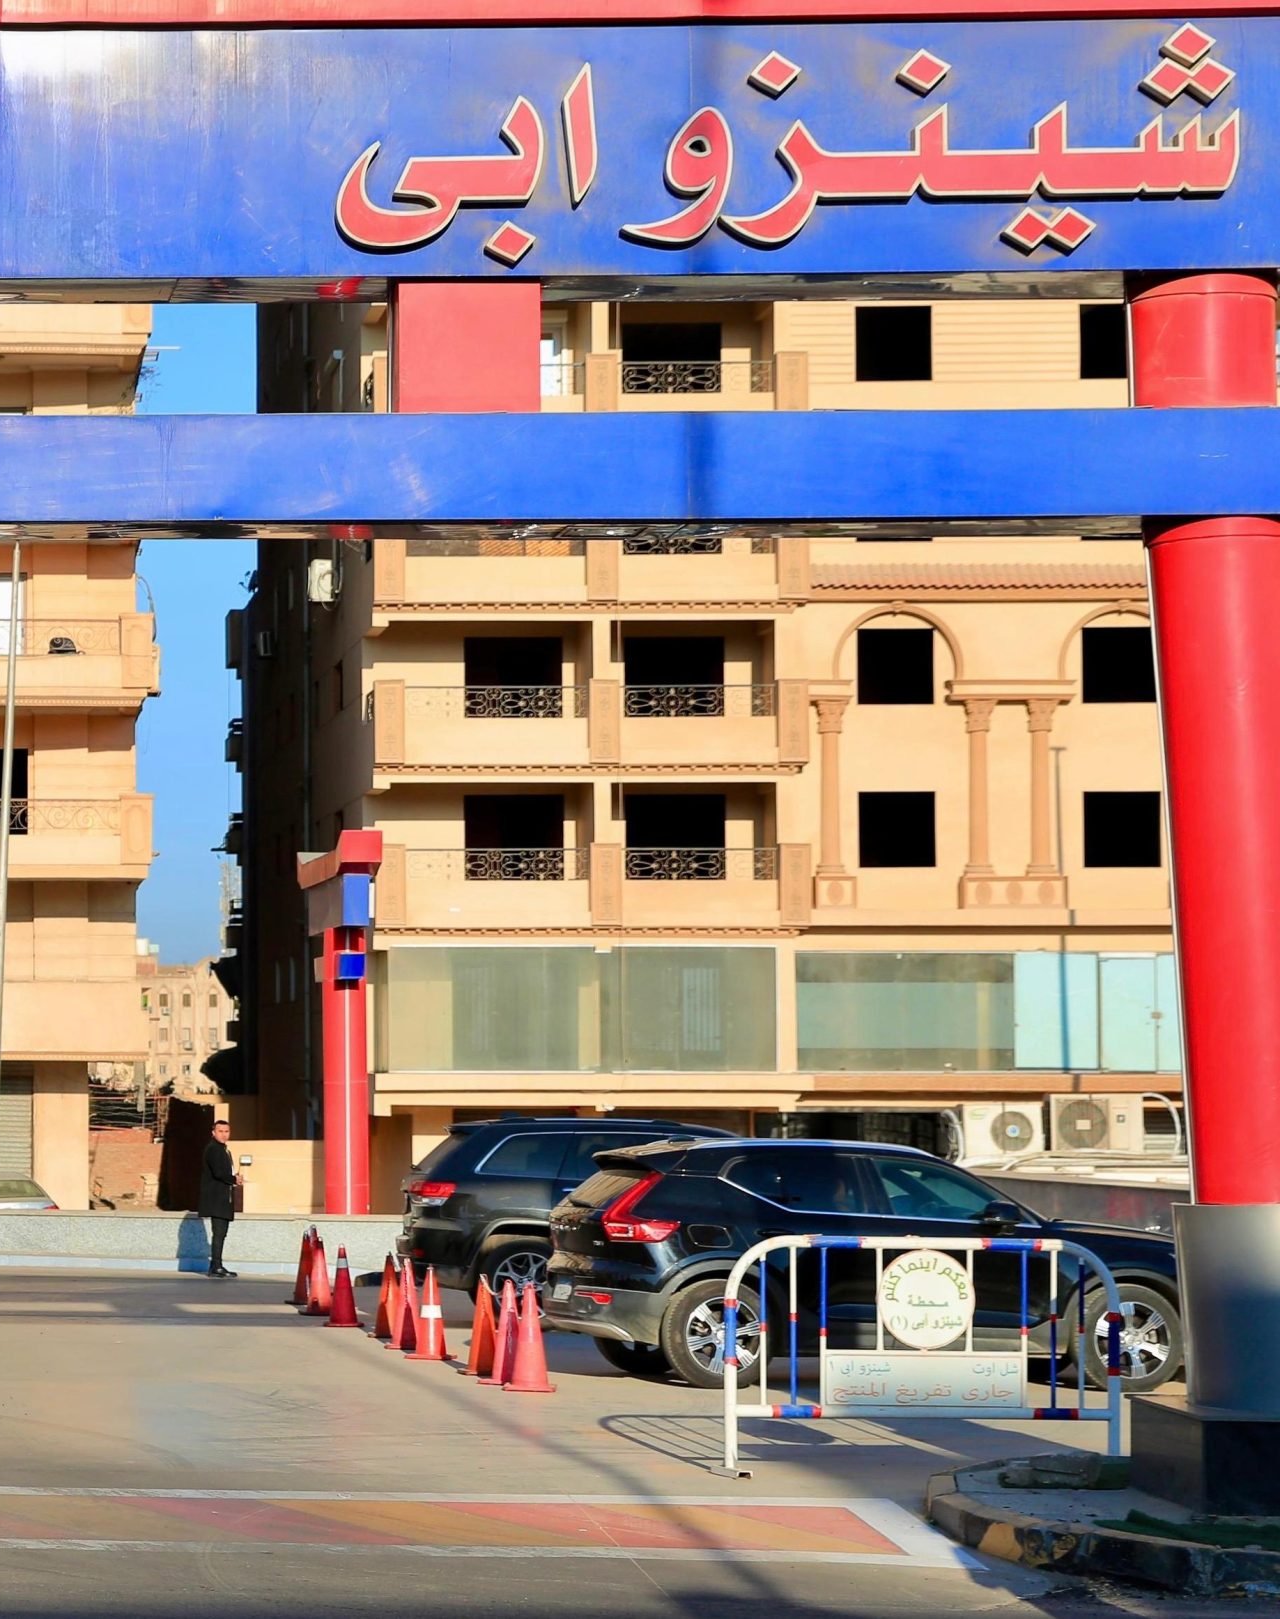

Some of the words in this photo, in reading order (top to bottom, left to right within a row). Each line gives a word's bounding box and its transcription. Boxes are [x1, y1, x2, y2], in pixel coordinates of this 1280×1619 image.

[620, 21, 1240, 256] شينزو
[937, 1267, 968, 1300] معكم
[833, 1382, 886, 1403] المنتج
